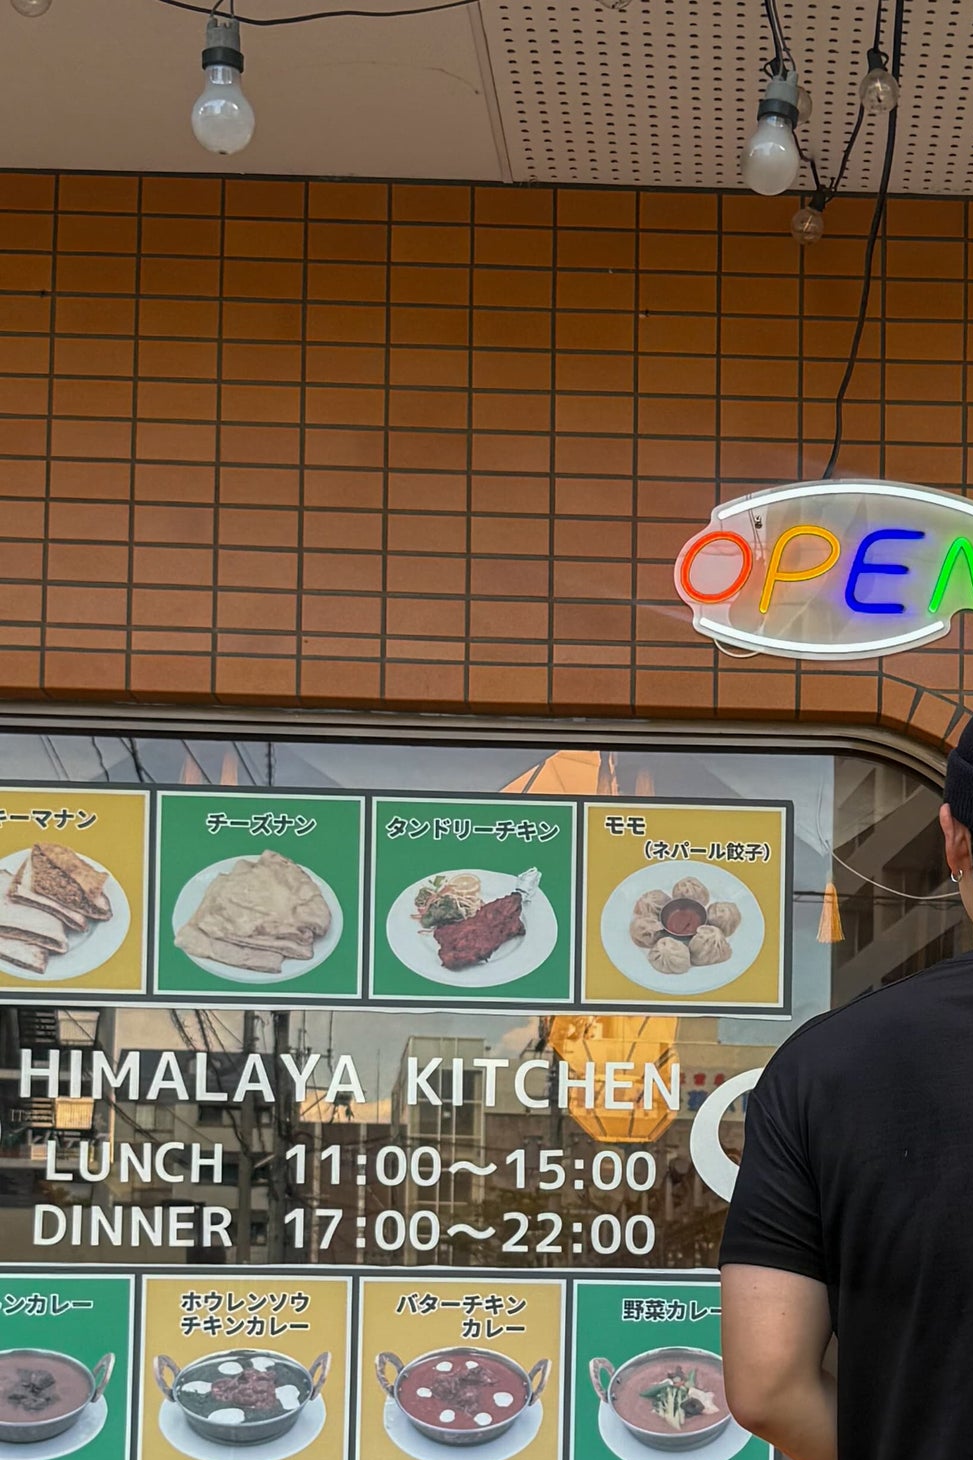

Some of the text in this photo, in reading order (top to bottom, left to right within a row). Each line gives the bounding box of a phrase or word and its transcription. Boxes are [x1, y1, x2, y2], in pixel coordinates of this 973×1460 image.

[206, 812, 317, 836] チーズナン
[385, 816, 560, 842] タンドリーチキン
[604, 815, 646, 837] モモ
[644, 838, 771, 863] (ネパール餃子)
[19, 1048, 366, 1103] HIMALAYA
[406, 1056, 681, 1111] KITCHEN
[45, 1140, 224, 1184] LUNCH
[33, 1203, 233, 1248] DINNER
[181, 1291, 310, 1313] ホウレンソウ
[396, 1292, 528, 1317] バターチキン
[180, 1314, 310, 1337] チキンカレー
[461, 1317, 526, 1340] カレー
